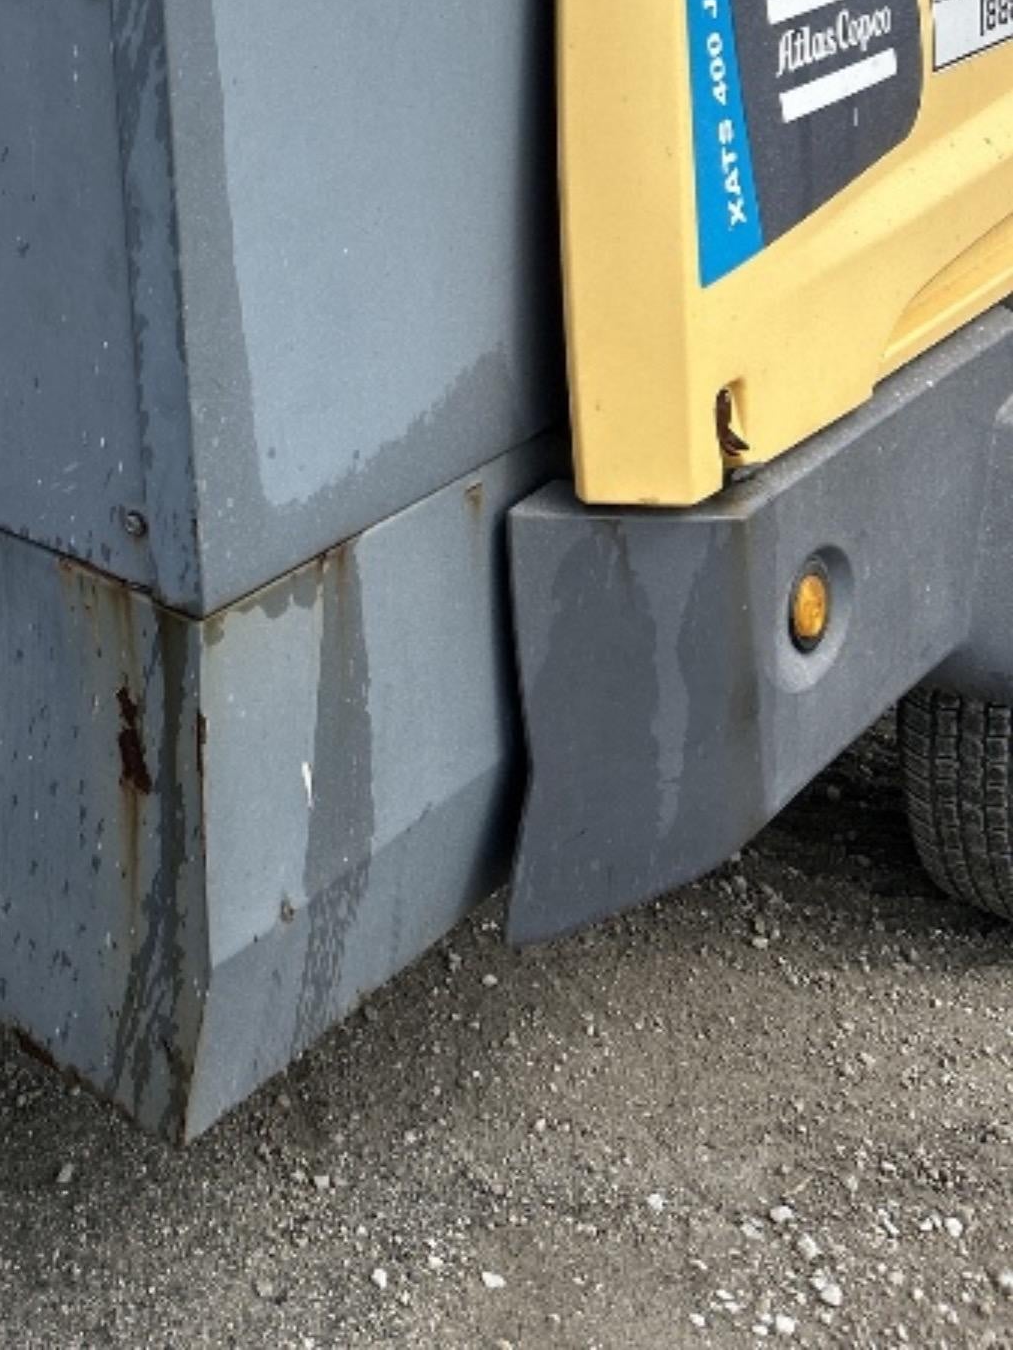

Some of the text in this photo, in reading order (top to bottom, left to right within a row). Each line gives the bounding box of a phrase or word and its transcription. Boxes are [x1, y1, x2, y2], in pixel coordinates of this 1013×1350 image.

[706, 32, 728, 106] 400
[775, 6, 892, 78] Atlas Copco
[717, 118, 747, 227] XATS
